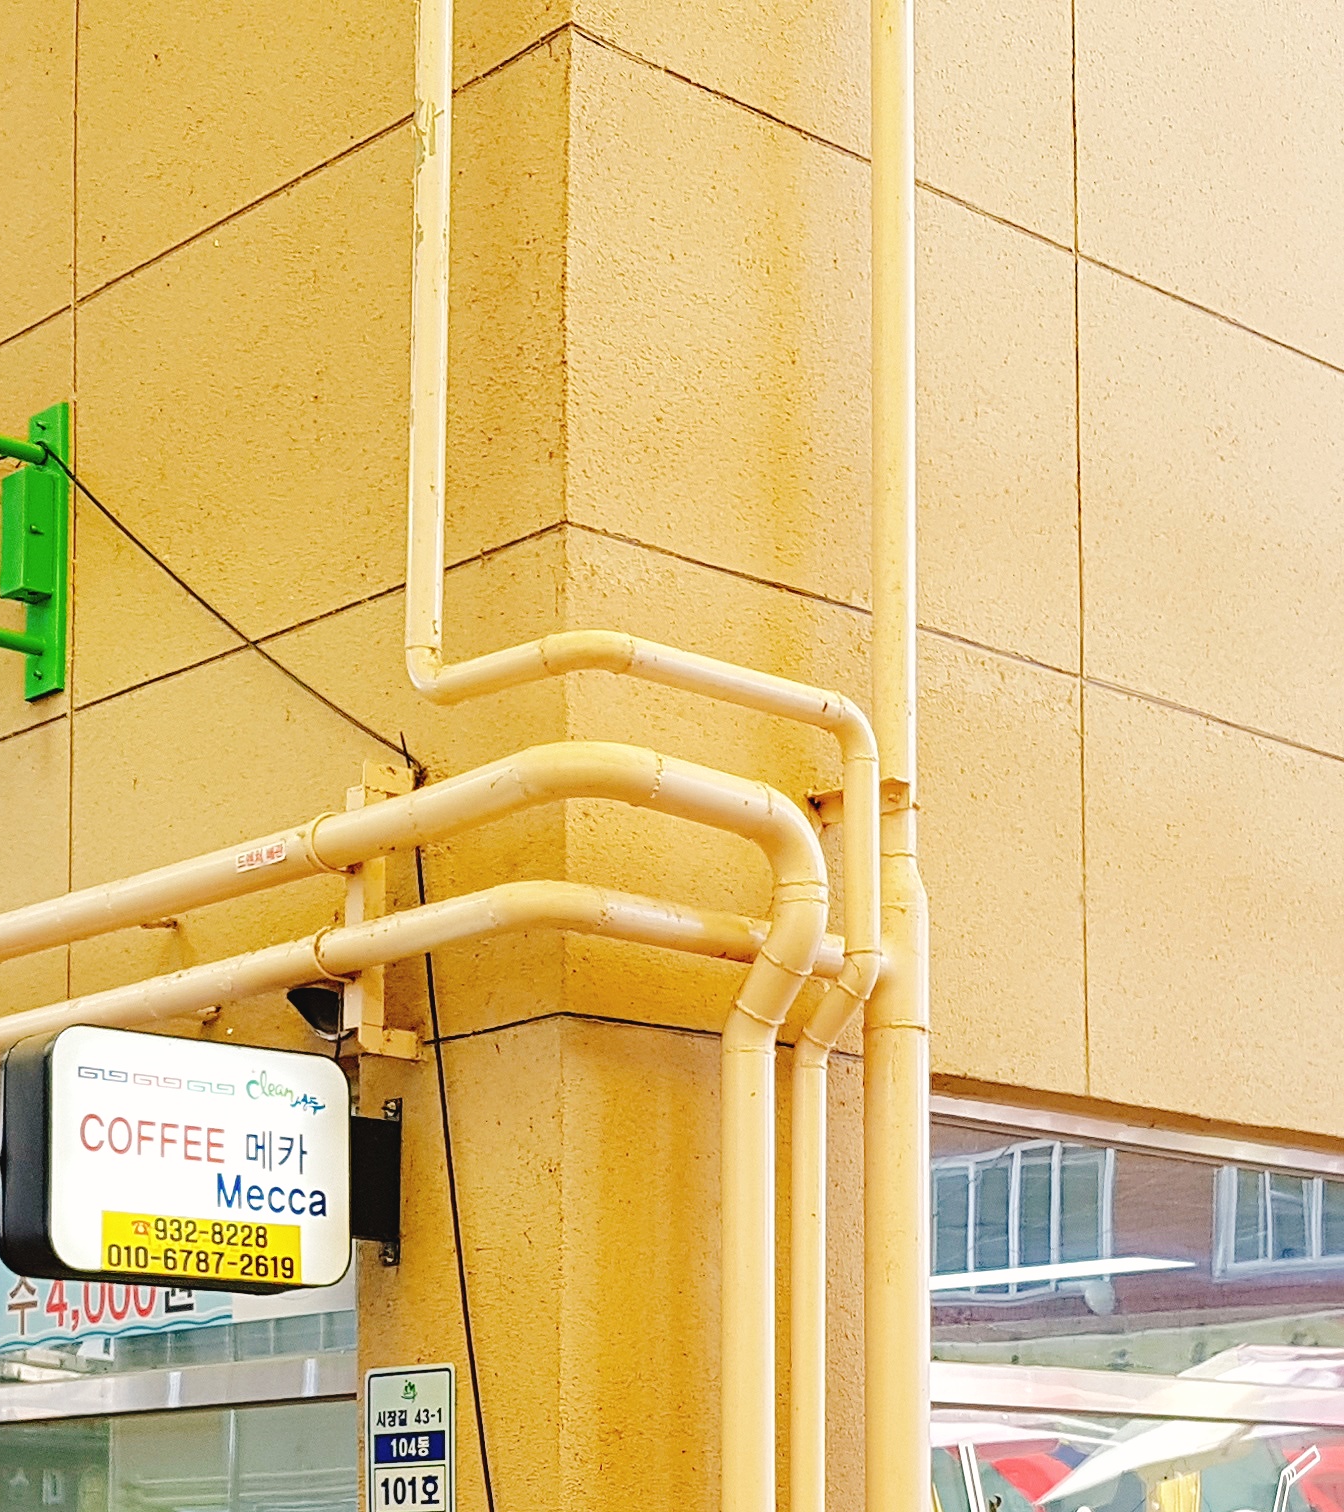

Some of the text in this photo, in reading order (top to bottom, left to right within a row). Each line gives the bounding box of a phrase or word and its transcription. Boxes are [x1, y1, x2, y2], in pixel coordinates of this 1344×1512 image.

[80, 1113, 308, 1175] COFFEE 메카
[216, 1172, 328, 1216] Mecca
[154, 1217, 268, 1249] 932-8228
[108, 1244, 294, 1279] 010-6787-2619
[376, 1408, 442, 1428] 시장길 43-1
[390, 1436, 430, 1458] 104동
[380, 1475, 440, 1506] 101호
